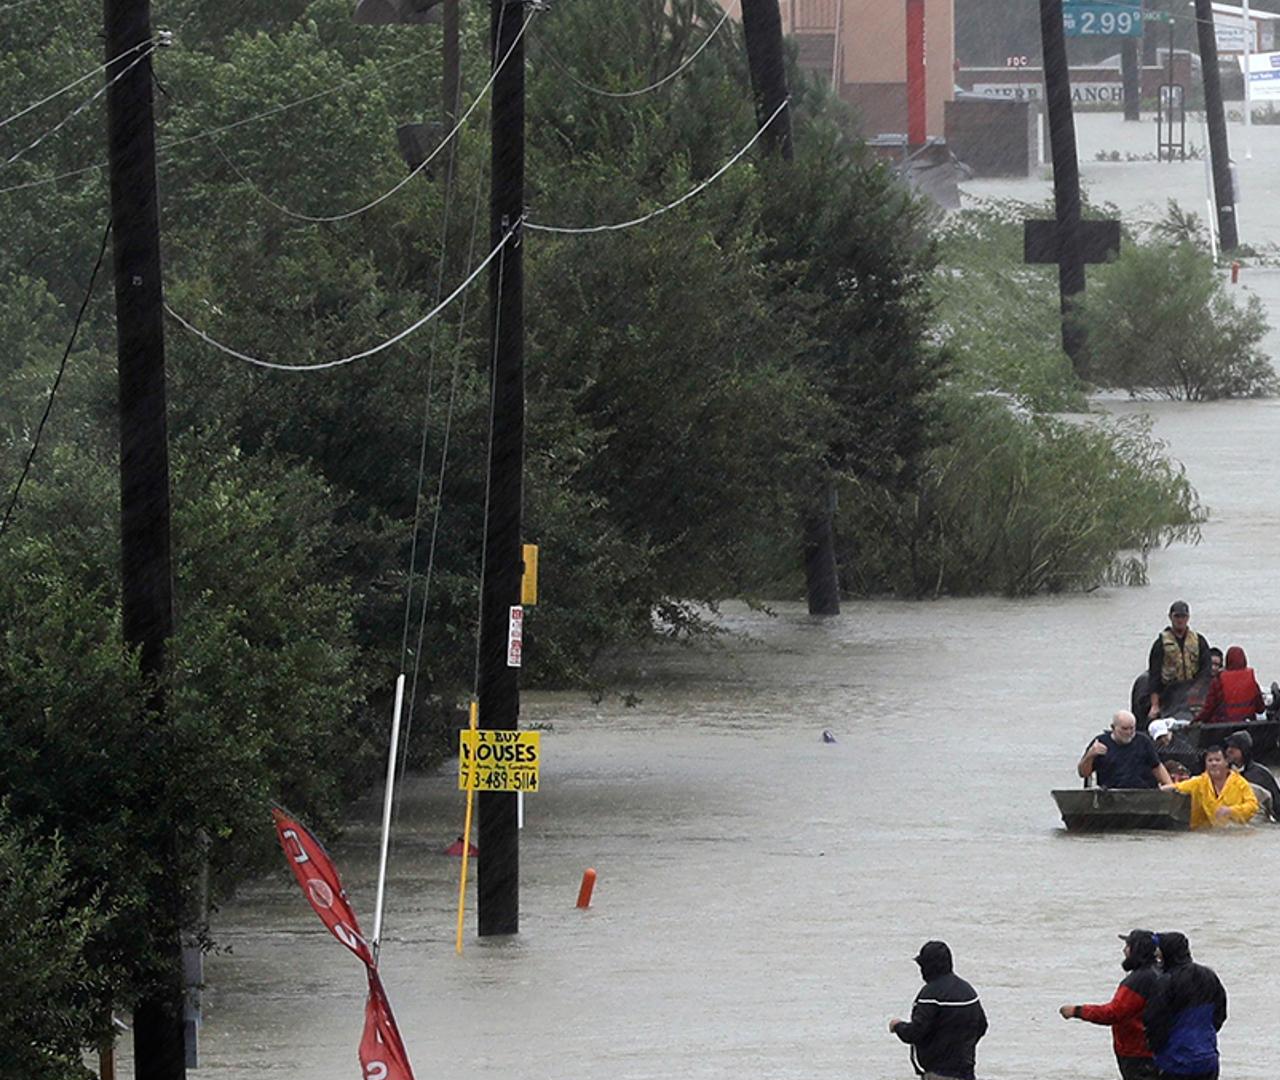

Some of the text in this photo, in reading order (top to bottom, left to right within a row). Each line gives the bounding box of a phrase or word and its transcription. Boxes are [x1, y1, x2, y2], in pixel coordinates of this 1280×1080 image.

[1072, 87, 1123, 101] ANCH
[478, 732, 521, 742] I BUY
[461, 771, 537, 789] 73-489-5114
